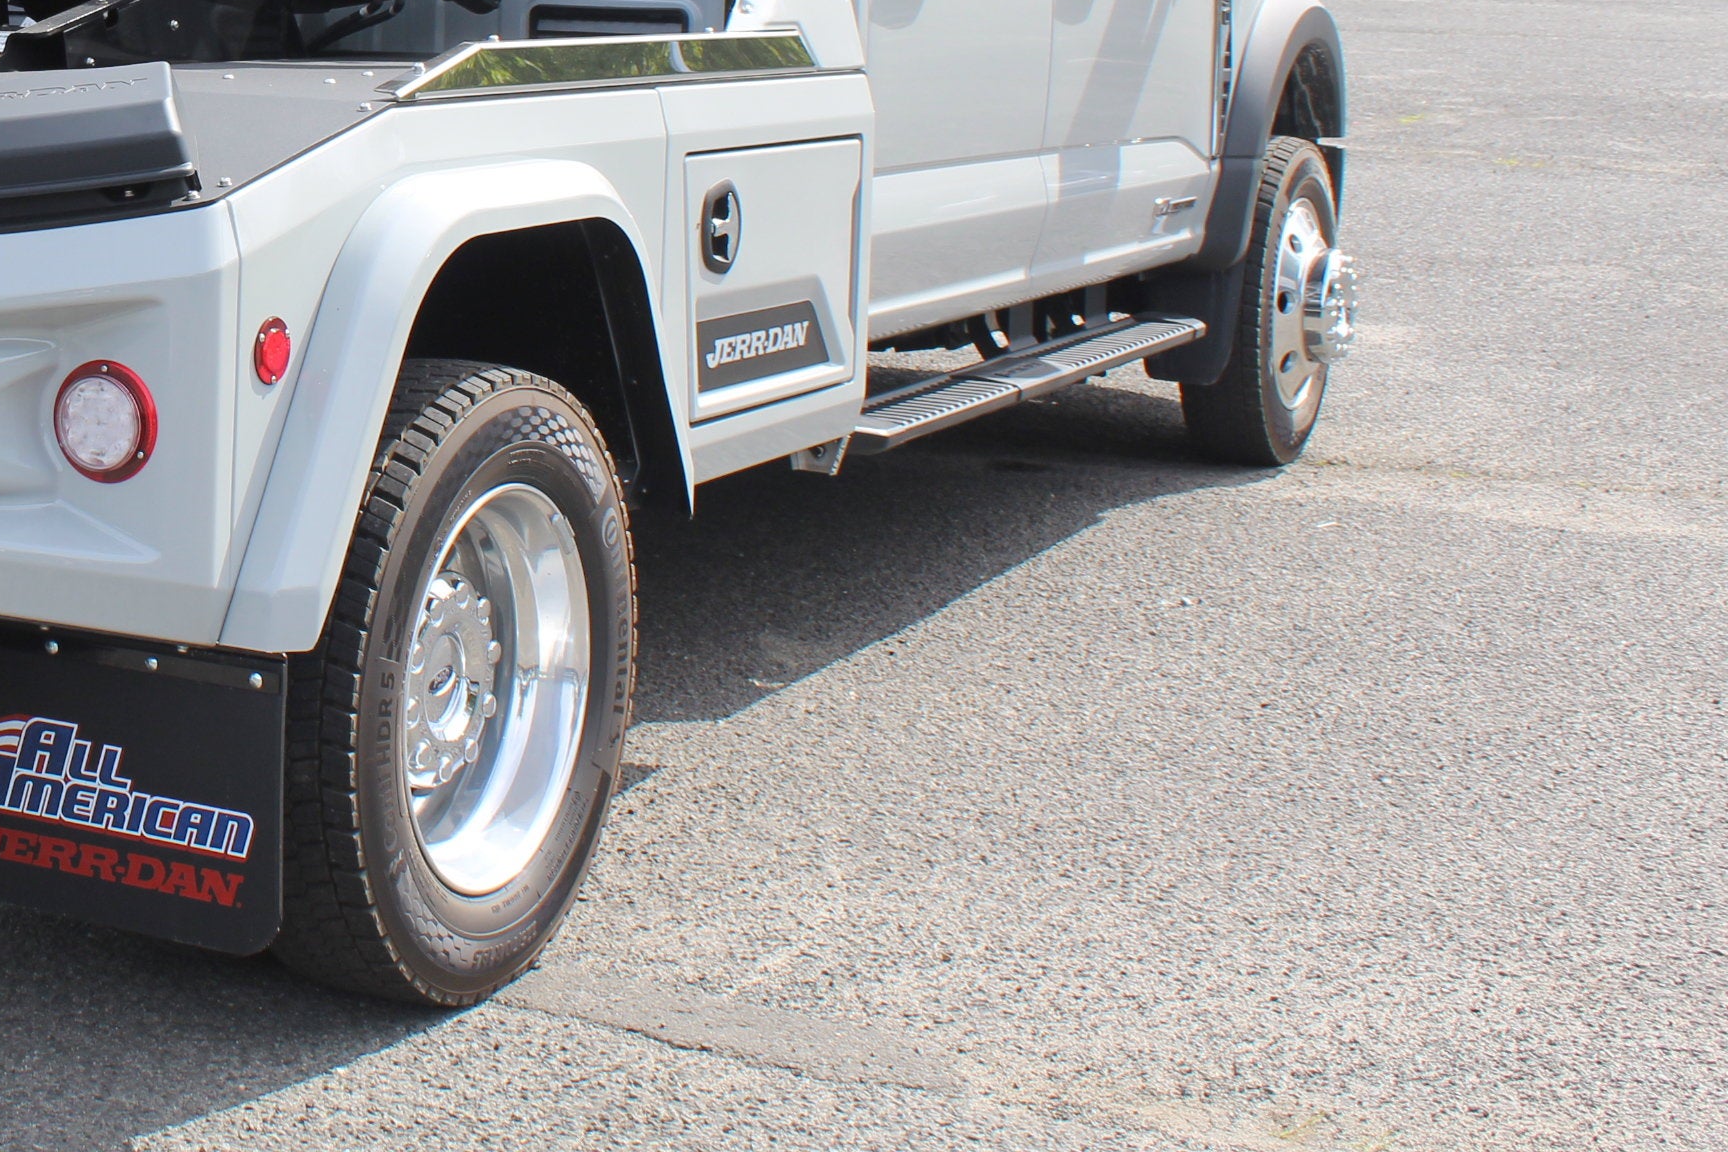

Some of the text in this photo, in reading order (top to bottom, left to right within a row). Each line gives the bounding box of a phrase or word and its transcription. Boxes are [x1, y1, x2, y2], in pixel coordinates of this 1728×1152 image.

[380, 671, 395, 691] 5
[16, 716, 132, 792] ALL
[377, 698, 393, 767] HDR
